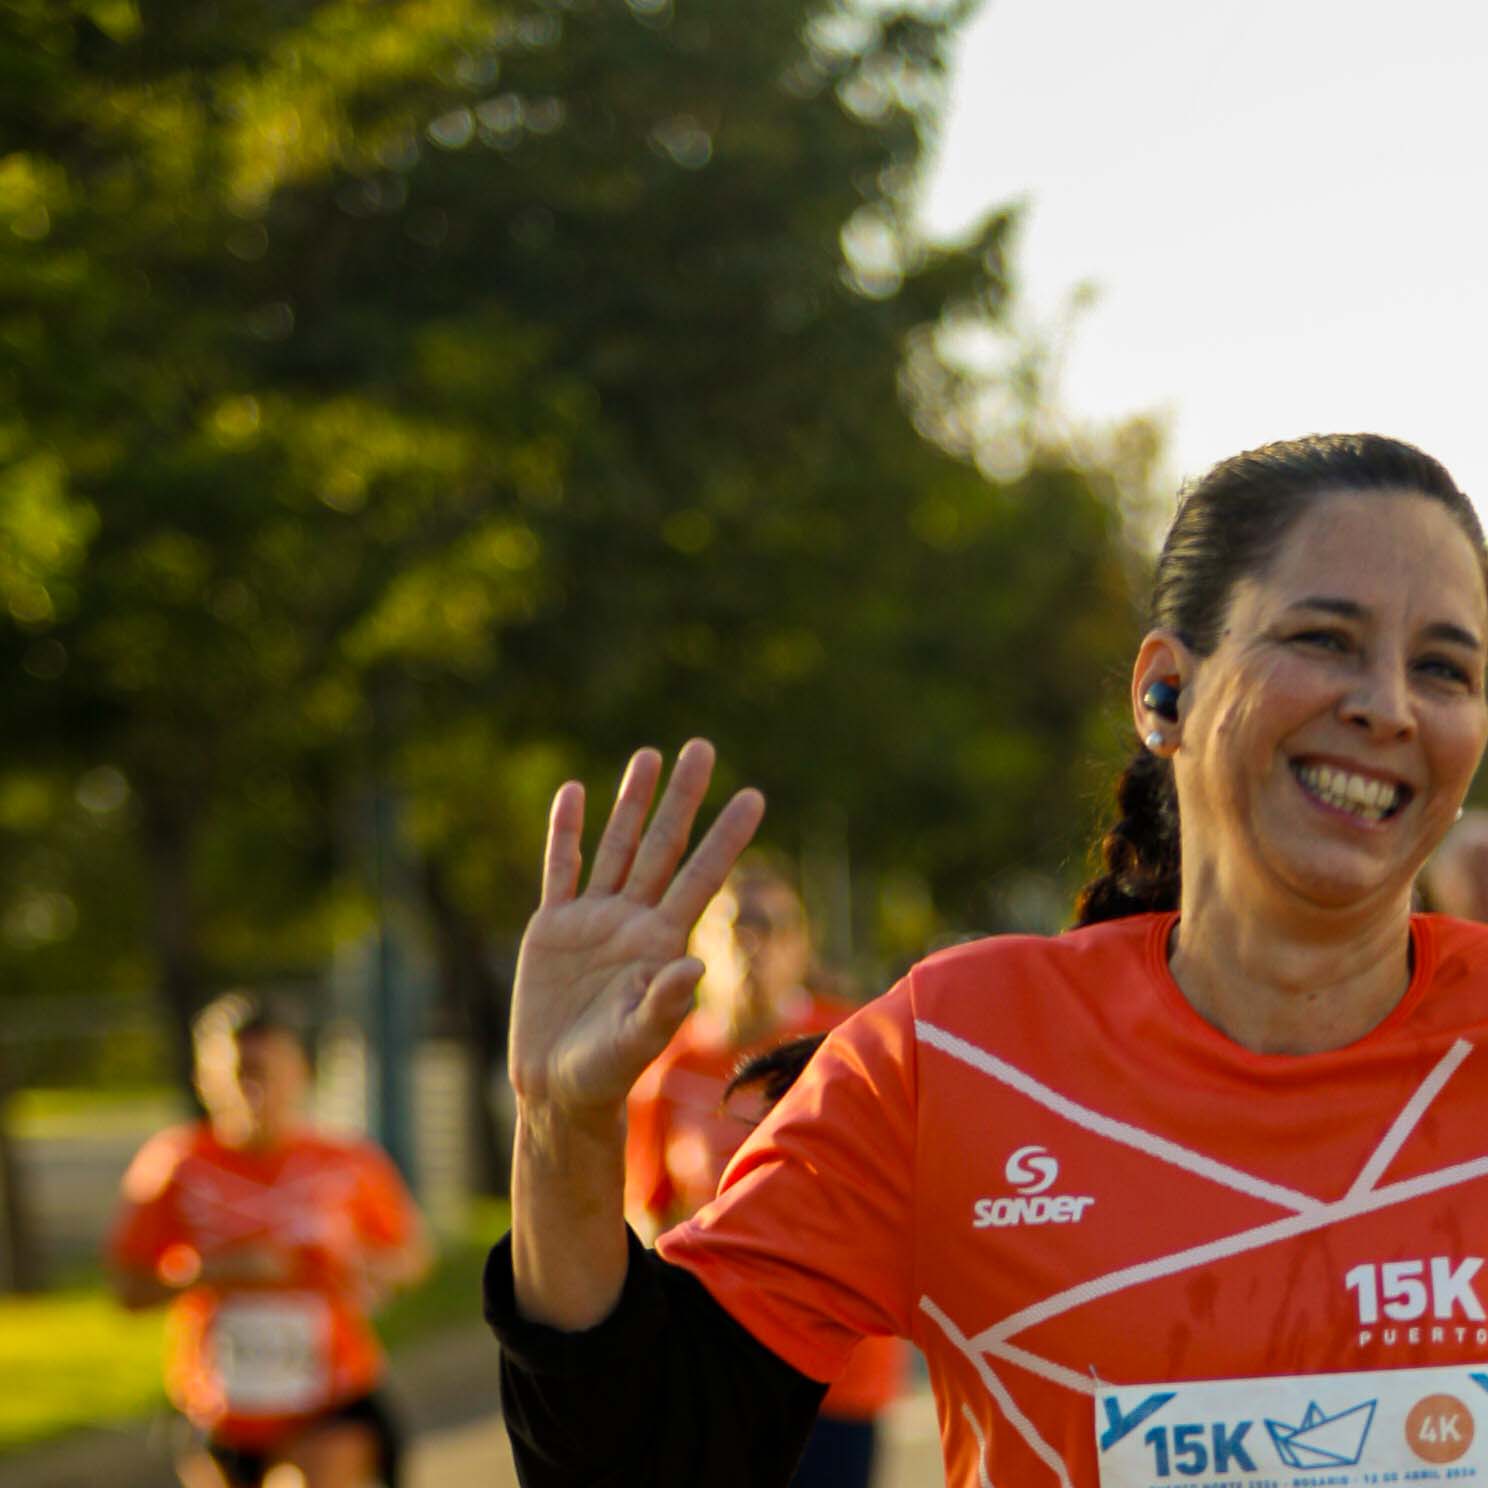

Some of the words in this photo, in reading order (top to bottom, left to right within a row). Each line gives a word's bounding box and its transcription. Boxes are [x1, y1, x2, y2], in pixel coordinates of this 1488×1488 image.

[1345, 1256, 1487, 1324] 15K
[1358, 1326, 1488, 1346] PUERTO
[1144, 1420, 1258, 1477] 15K
[1418, 1415, 1463, 1444] 4K
